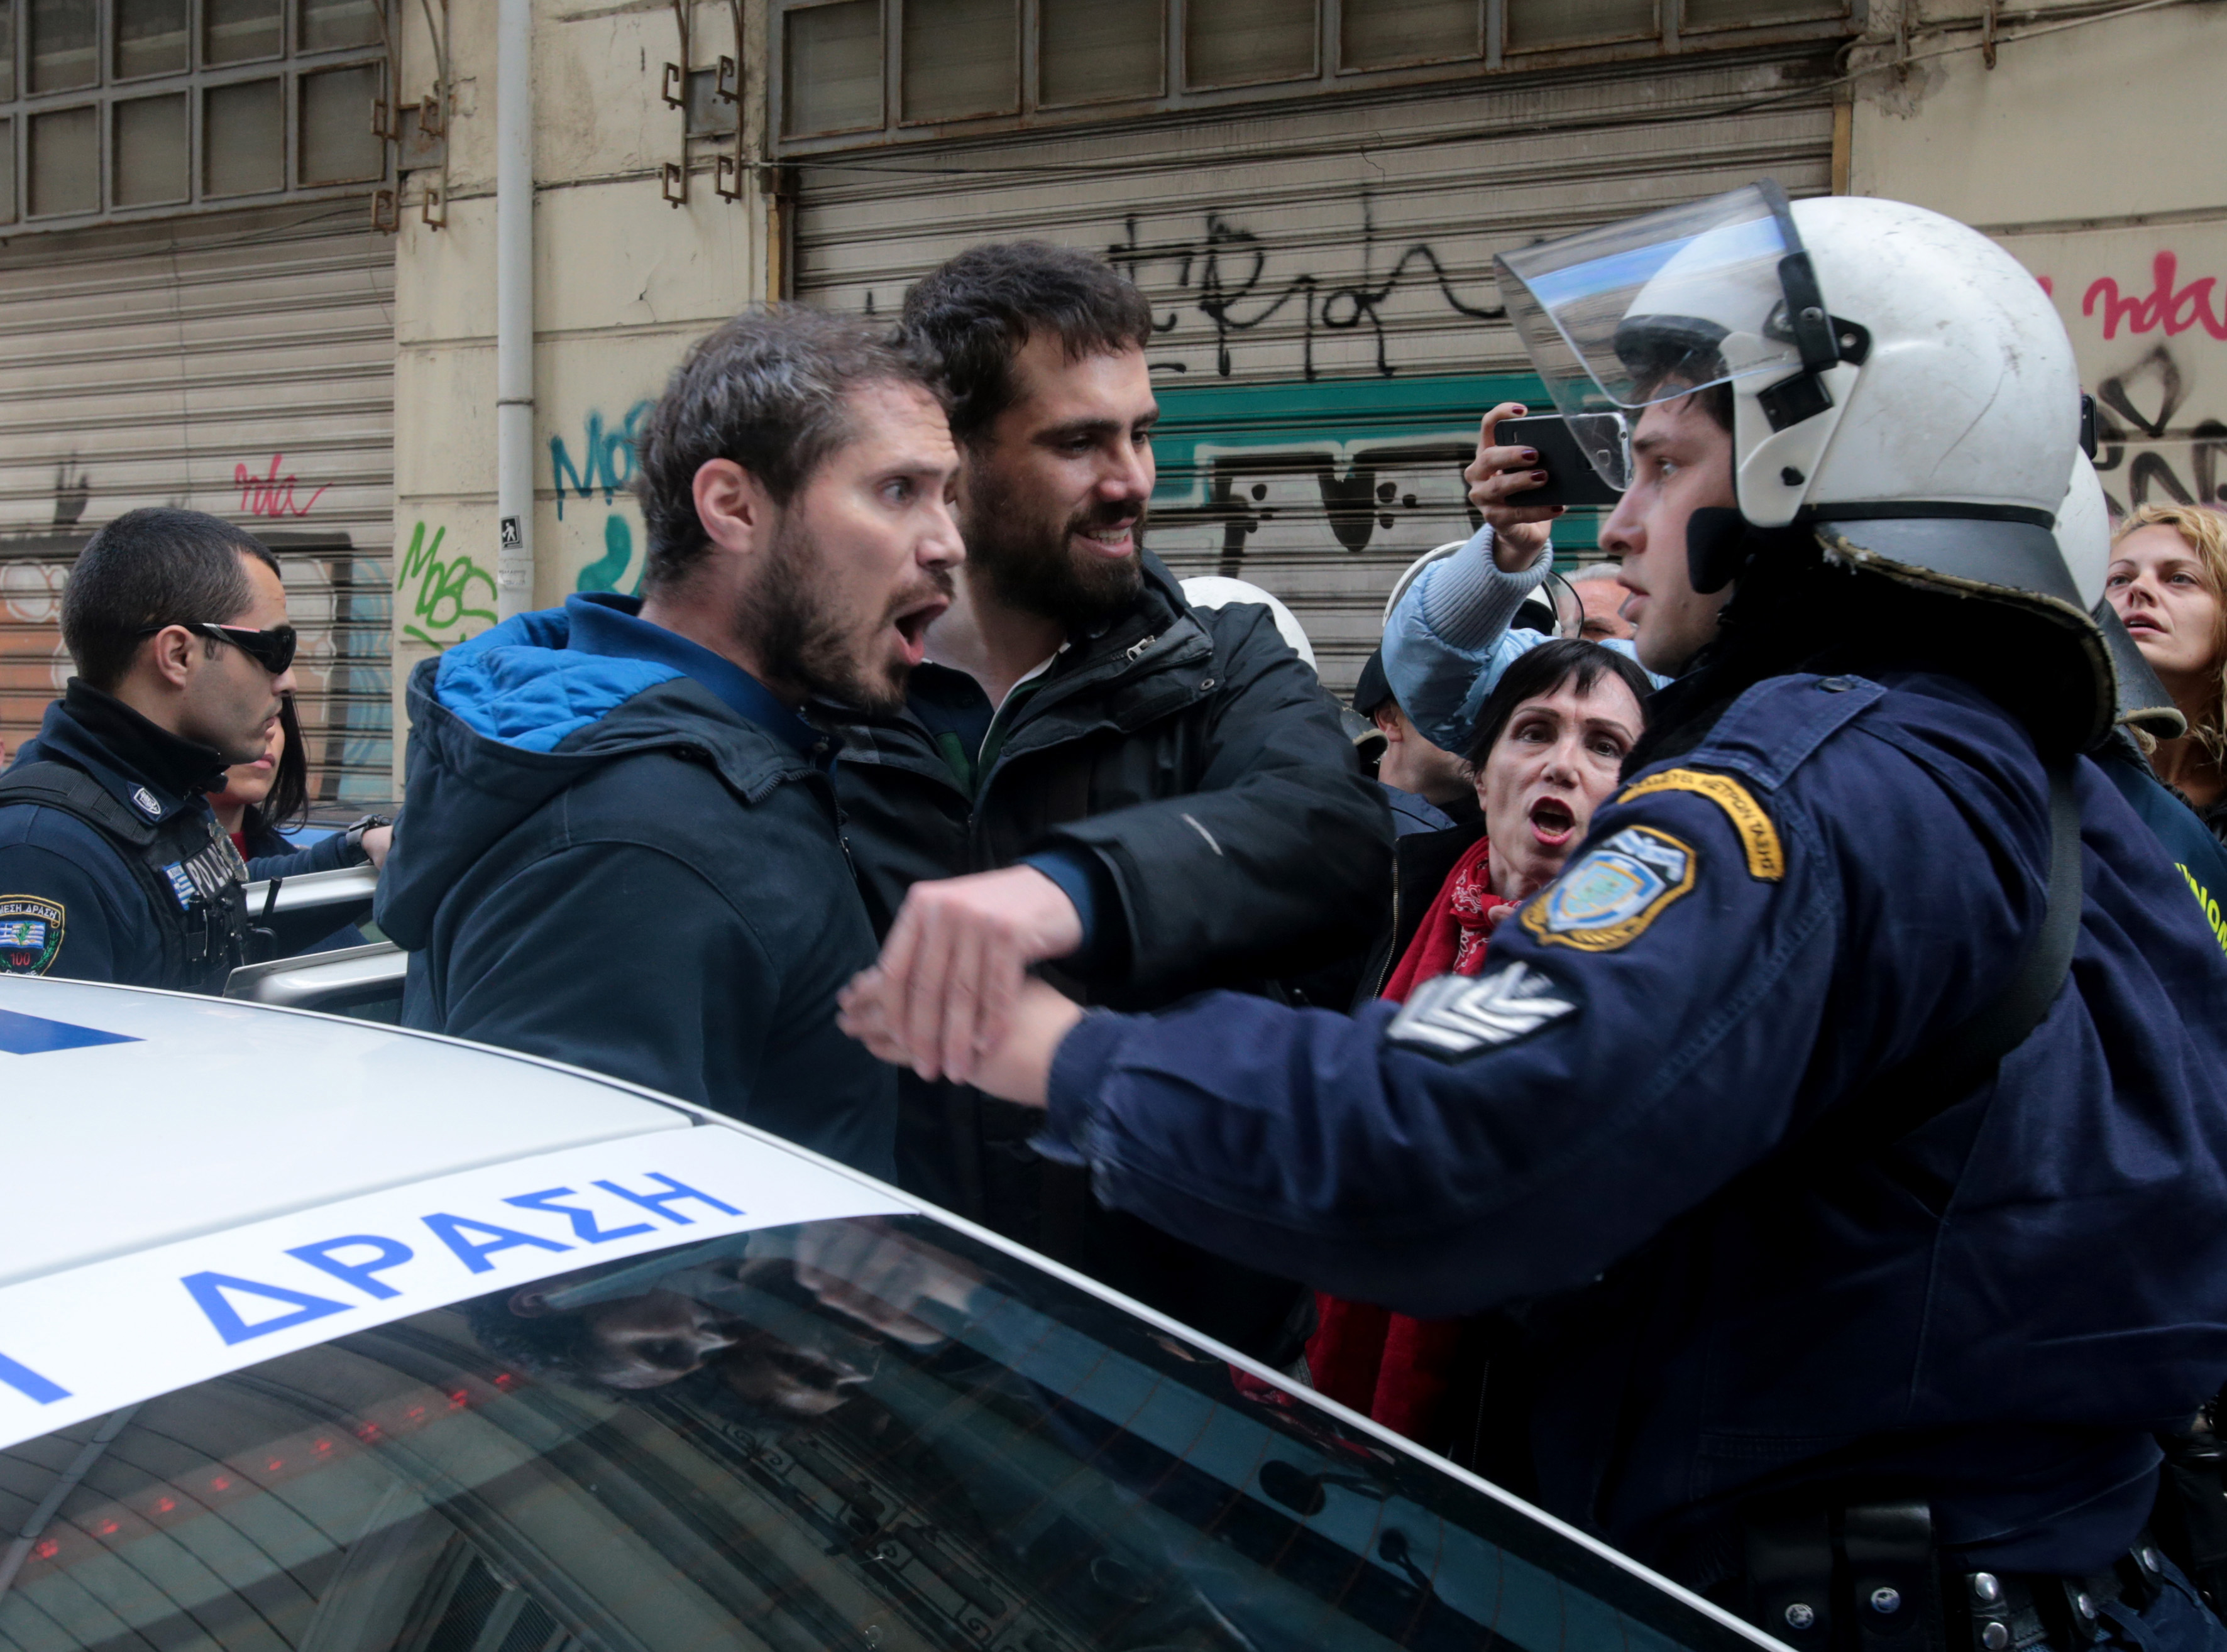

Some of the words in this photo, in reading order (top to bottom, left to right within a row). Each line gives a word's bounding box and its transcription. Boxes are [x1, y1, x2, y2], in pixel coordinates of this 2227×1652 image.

[25, 904, 58, 920] ΔΡΑΣΗ
[11, 952, 31, 966] 100
[179, 1171, 747, 1347] ΔΡΑΣΗ
